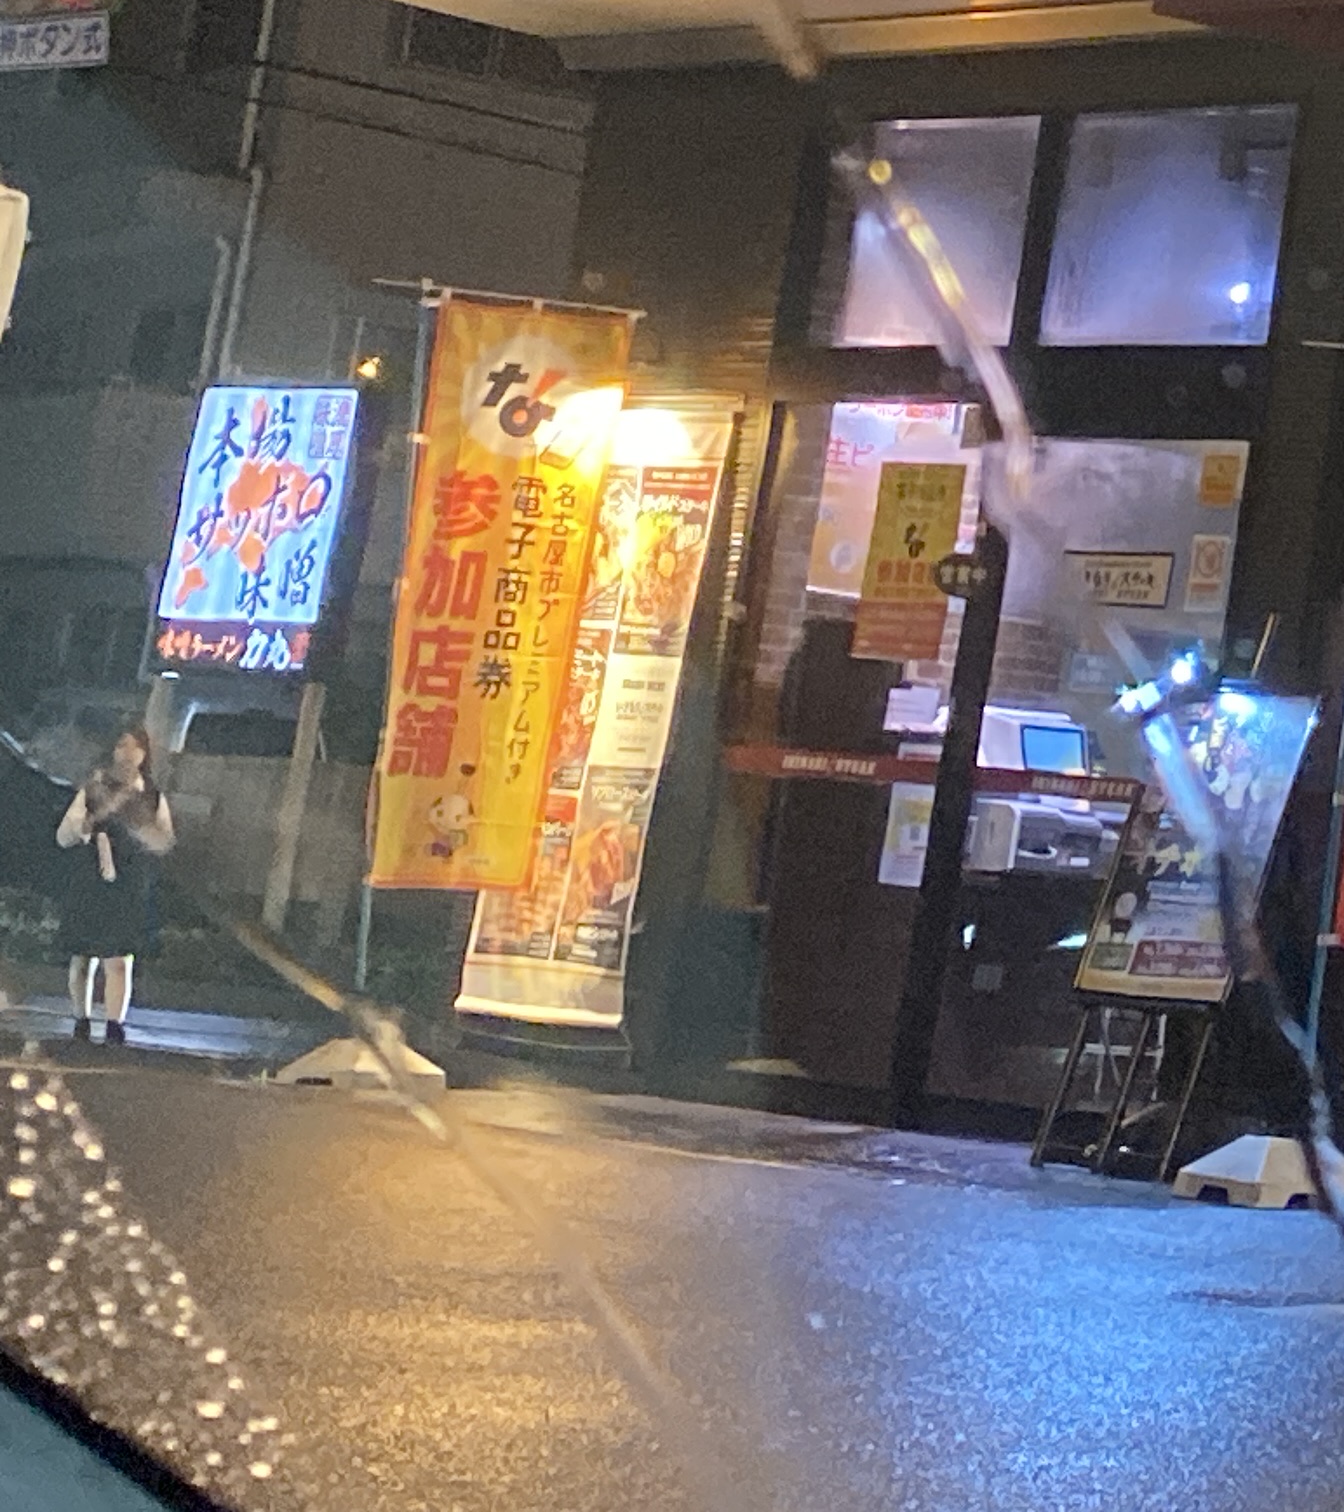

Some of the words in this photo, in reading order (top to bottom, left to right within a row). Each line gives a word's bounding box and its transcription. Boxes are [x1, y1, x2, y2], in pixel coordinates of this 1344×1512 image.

[387, 470, 501, 778] 参加店舗
[474, 476, 547, 700] 電子商品券
